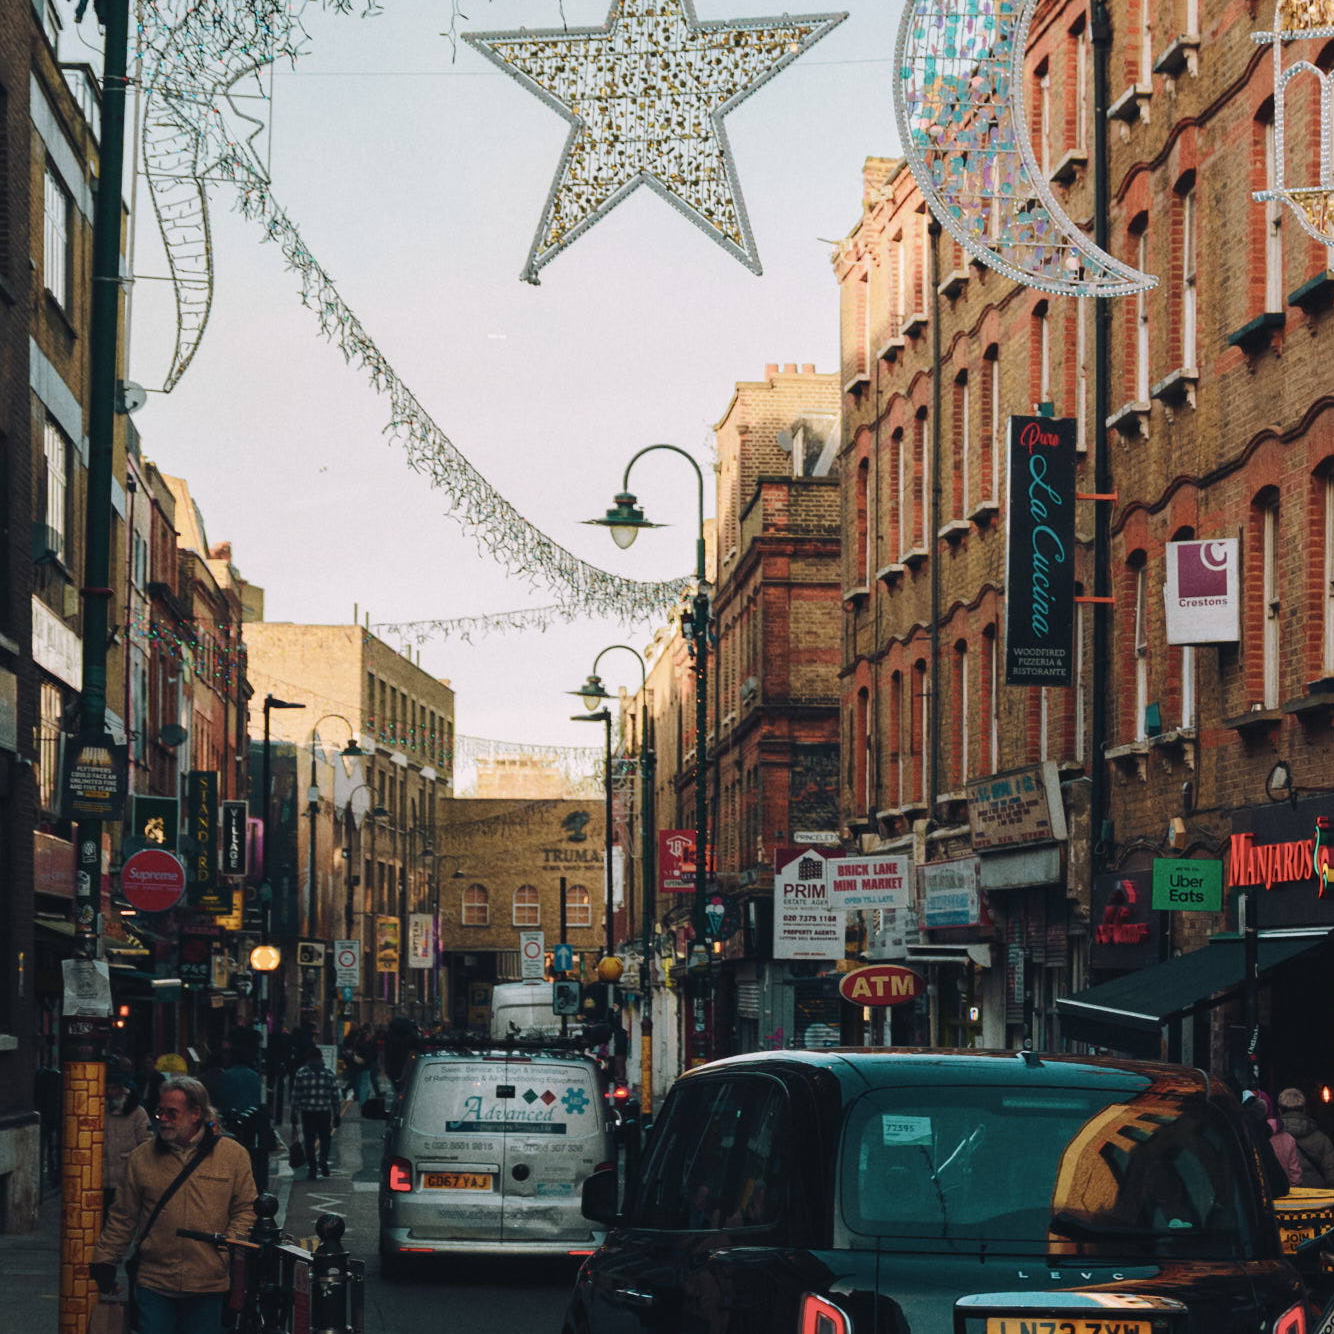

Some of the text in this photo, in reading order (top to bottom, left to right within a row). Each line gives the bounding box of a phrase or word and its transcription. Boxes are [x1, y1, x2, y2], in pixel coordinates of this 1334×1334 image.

[1028, 454, 1065, 639] La Cucina
[1179, 598, 1228, 608] Crestons
[1013, 648, 1066, 657] WOODFIRED
[1018, 658, 1055, 666] PIZZERIA
[1013, 667, 1067, 676] RISTORANTE
[229, 809, 239, 869] VILLAGE
[543, 849, 604, 863] TRUMA
[129, 867, 179, 883] Supreme
[837, 862, 899, 877] BRICK LANE
[833, 877, 903, 892] MINI MARKET
[1170, 874, 1204, 888] Uber
[783, 883, 826, 898] PRIM
[1169, 889, 1205, 903] Eats
[878, 895, 895, 904] LATE
[851, 974, 915, 998] ATM
[451, 1096, 557, 1128] Advanced
[462, 1177, 488, 1189] YAJ
[1018, 1271, 1124, 1281] LEVC
